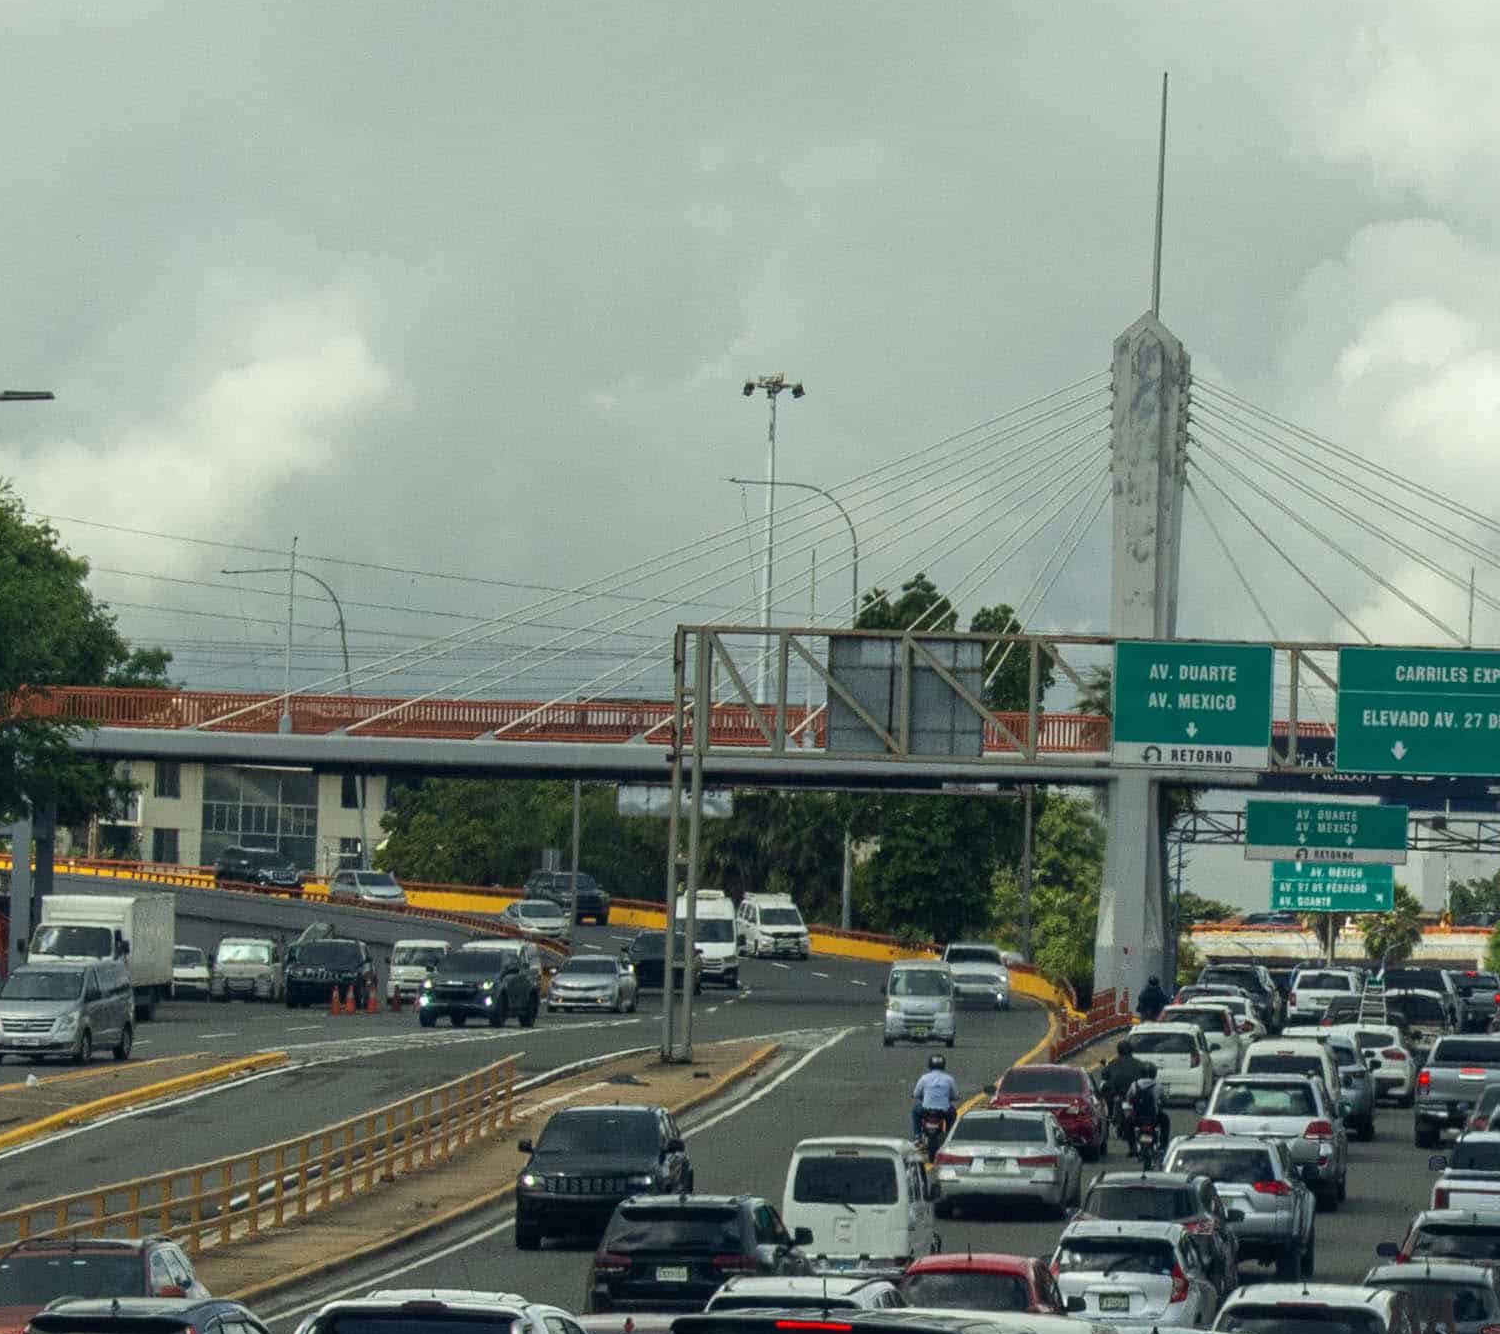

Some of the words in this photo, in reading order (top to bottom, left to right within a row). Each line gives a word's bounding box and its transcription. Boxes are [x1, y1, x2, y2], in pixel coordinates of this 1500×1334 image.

[1149, 664, 1173, 680] AV.
[1179, 665, 1237, 682] DUARTE
[1396, 665, 1468, 684] CARRILES
[1148, 692, 1173, 709] AV.
[1178, 693, 1237, 711] MEXICO
[1363, 710, 1429, 728] ELEVADO
[1434, 712, 1459, 729] AV.
[1464, 713, 1483, 729] 27
[1171, 749, 1233, 764] RETORNO
